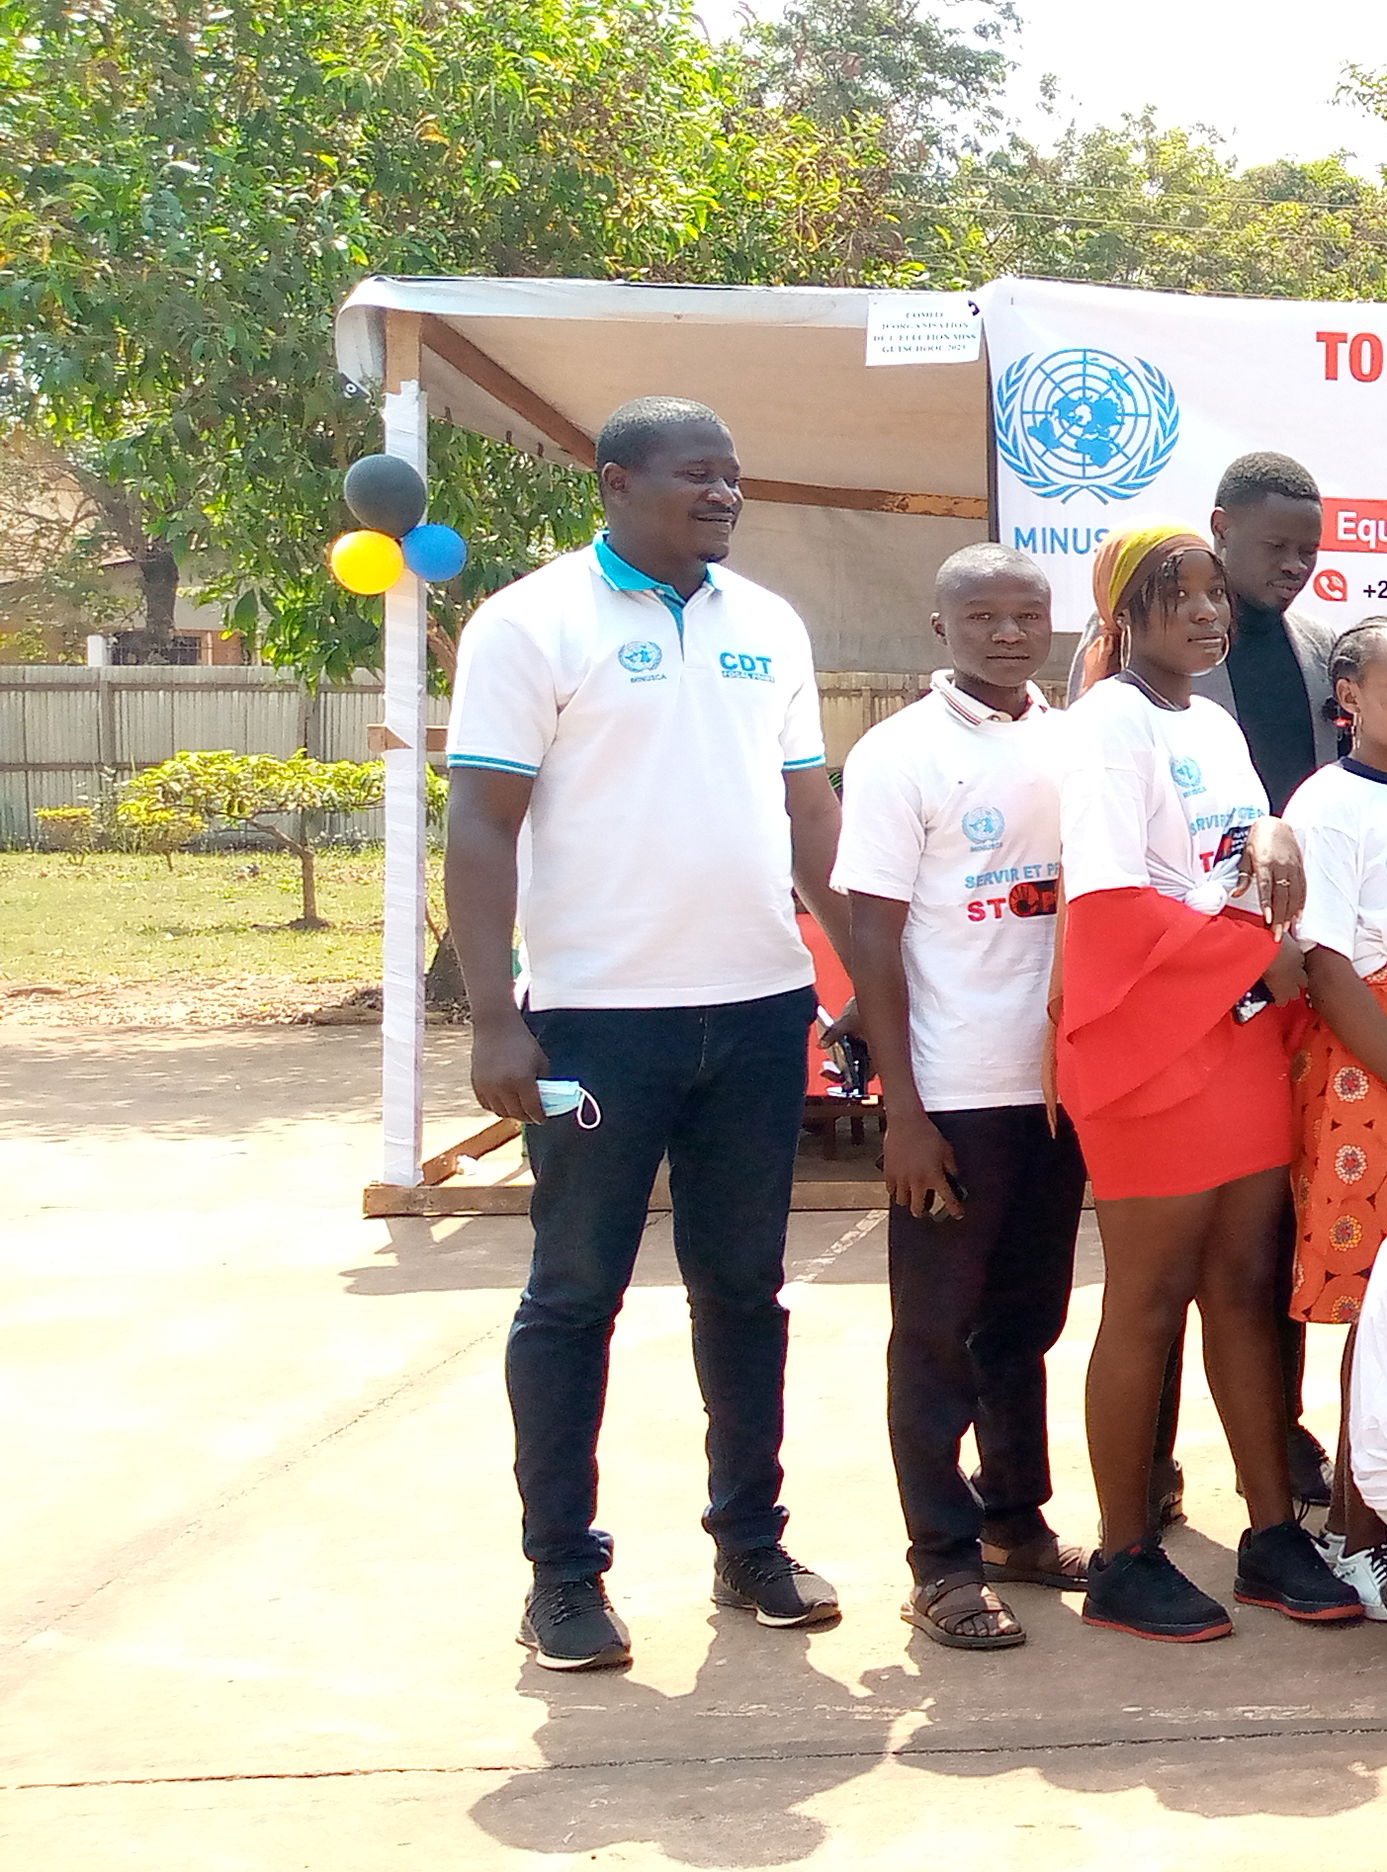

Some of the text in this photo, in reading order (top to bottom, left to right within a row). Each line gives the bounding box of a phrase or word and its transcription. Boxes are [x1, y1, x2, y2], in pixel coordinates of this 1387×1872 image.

[1013, 526, 1111, 555] MINUS
[719, 651, 772, 675] CDT
[964, 867, 1020, 889] SERVIR
[1023, 863, 1042, 880] ET
